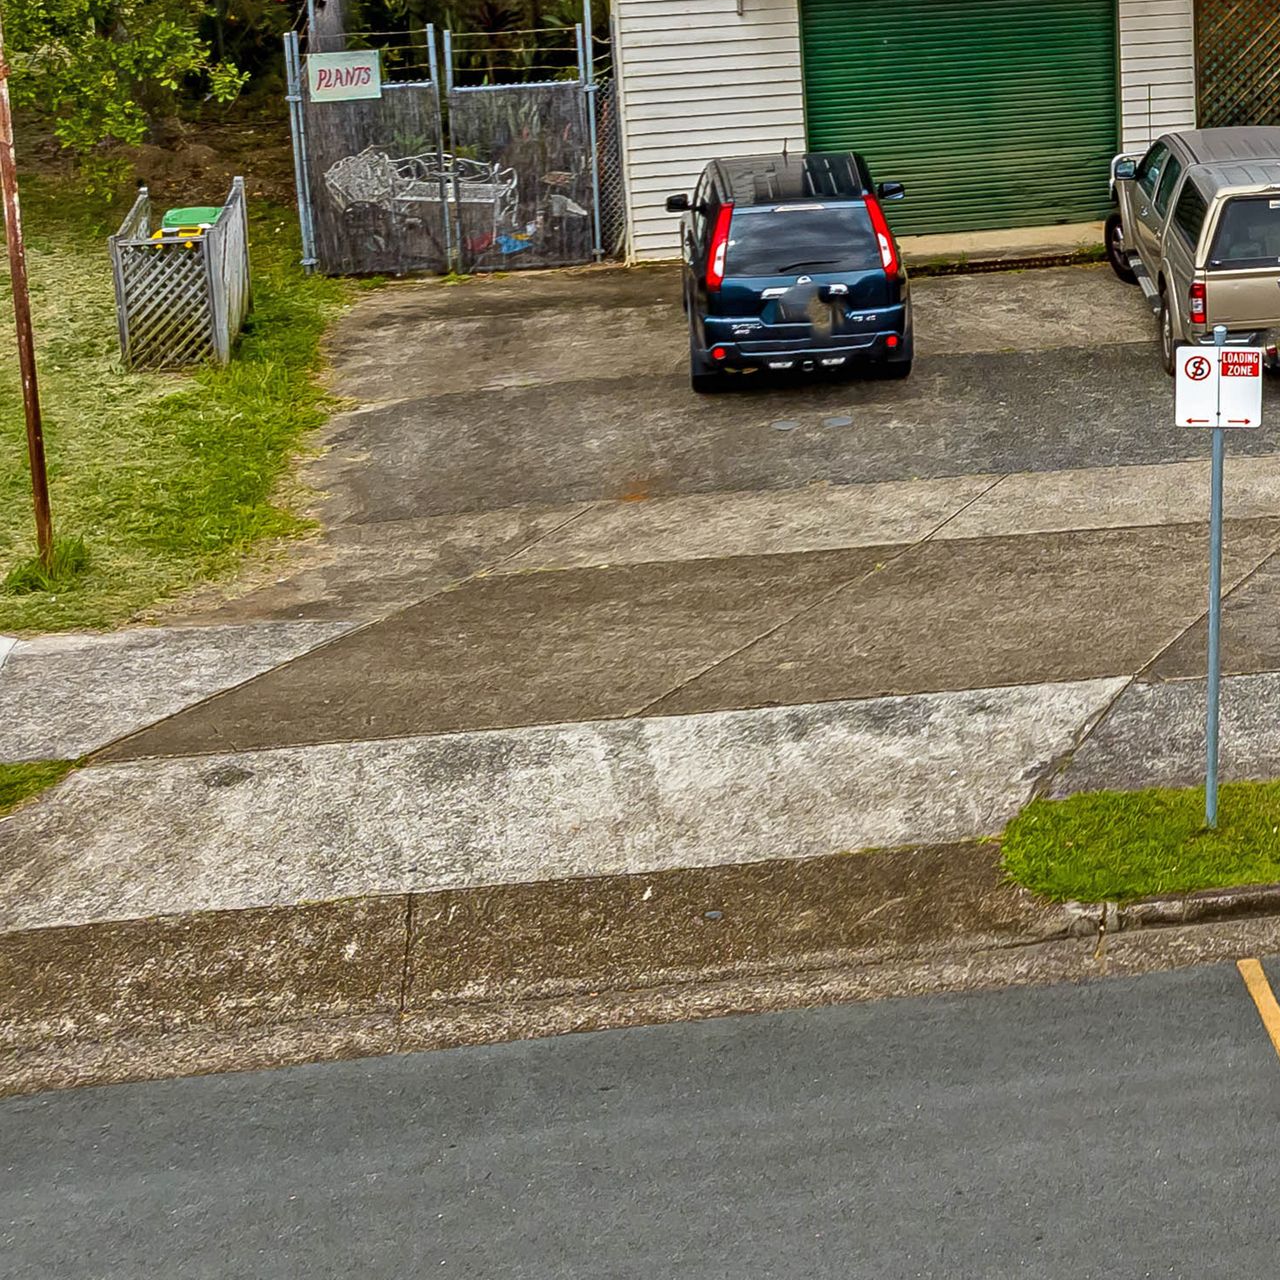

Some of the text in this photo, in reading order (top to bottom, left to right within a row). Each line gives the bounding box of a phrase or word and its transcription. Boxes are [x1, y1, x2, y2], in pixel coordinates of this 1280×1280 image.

[316, 66, 371, 91] PLANTS
[1222, 353, 1259, 363] LOADING
[1227, 365, 1253, 376] ZONE
